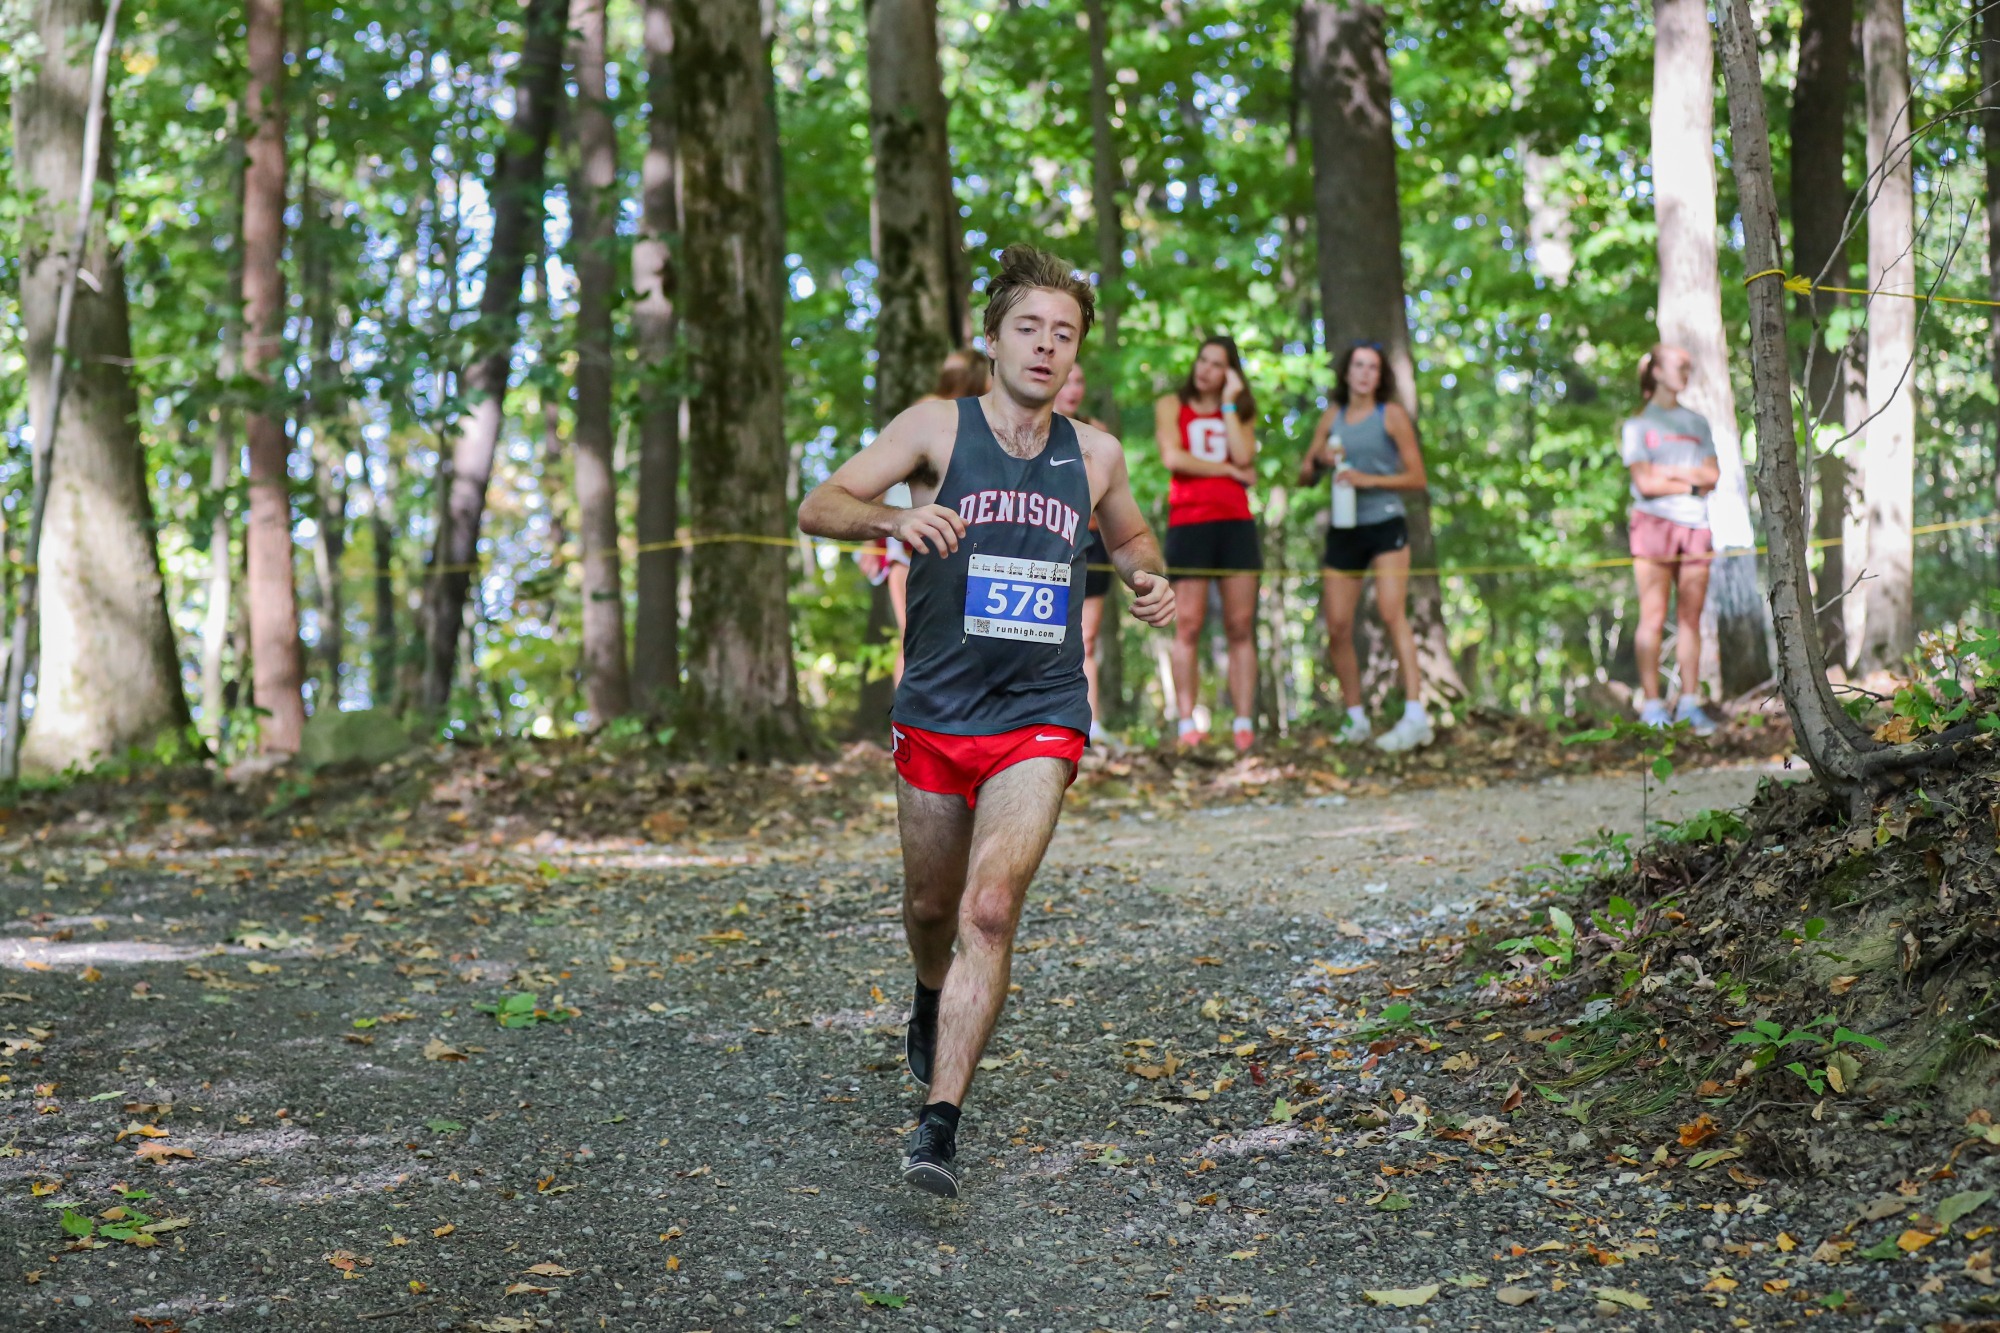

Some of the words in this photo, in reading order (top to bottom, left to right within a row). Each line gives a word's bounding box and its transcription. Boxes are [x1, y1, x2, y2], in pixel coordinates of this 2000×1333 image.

[1187, 418, 1227, 463] G
[960, 489, 1080, 546] DENISON
[985, 582, 1054, 620] 578
[996, 626, 1055, 638] runhigh.com
